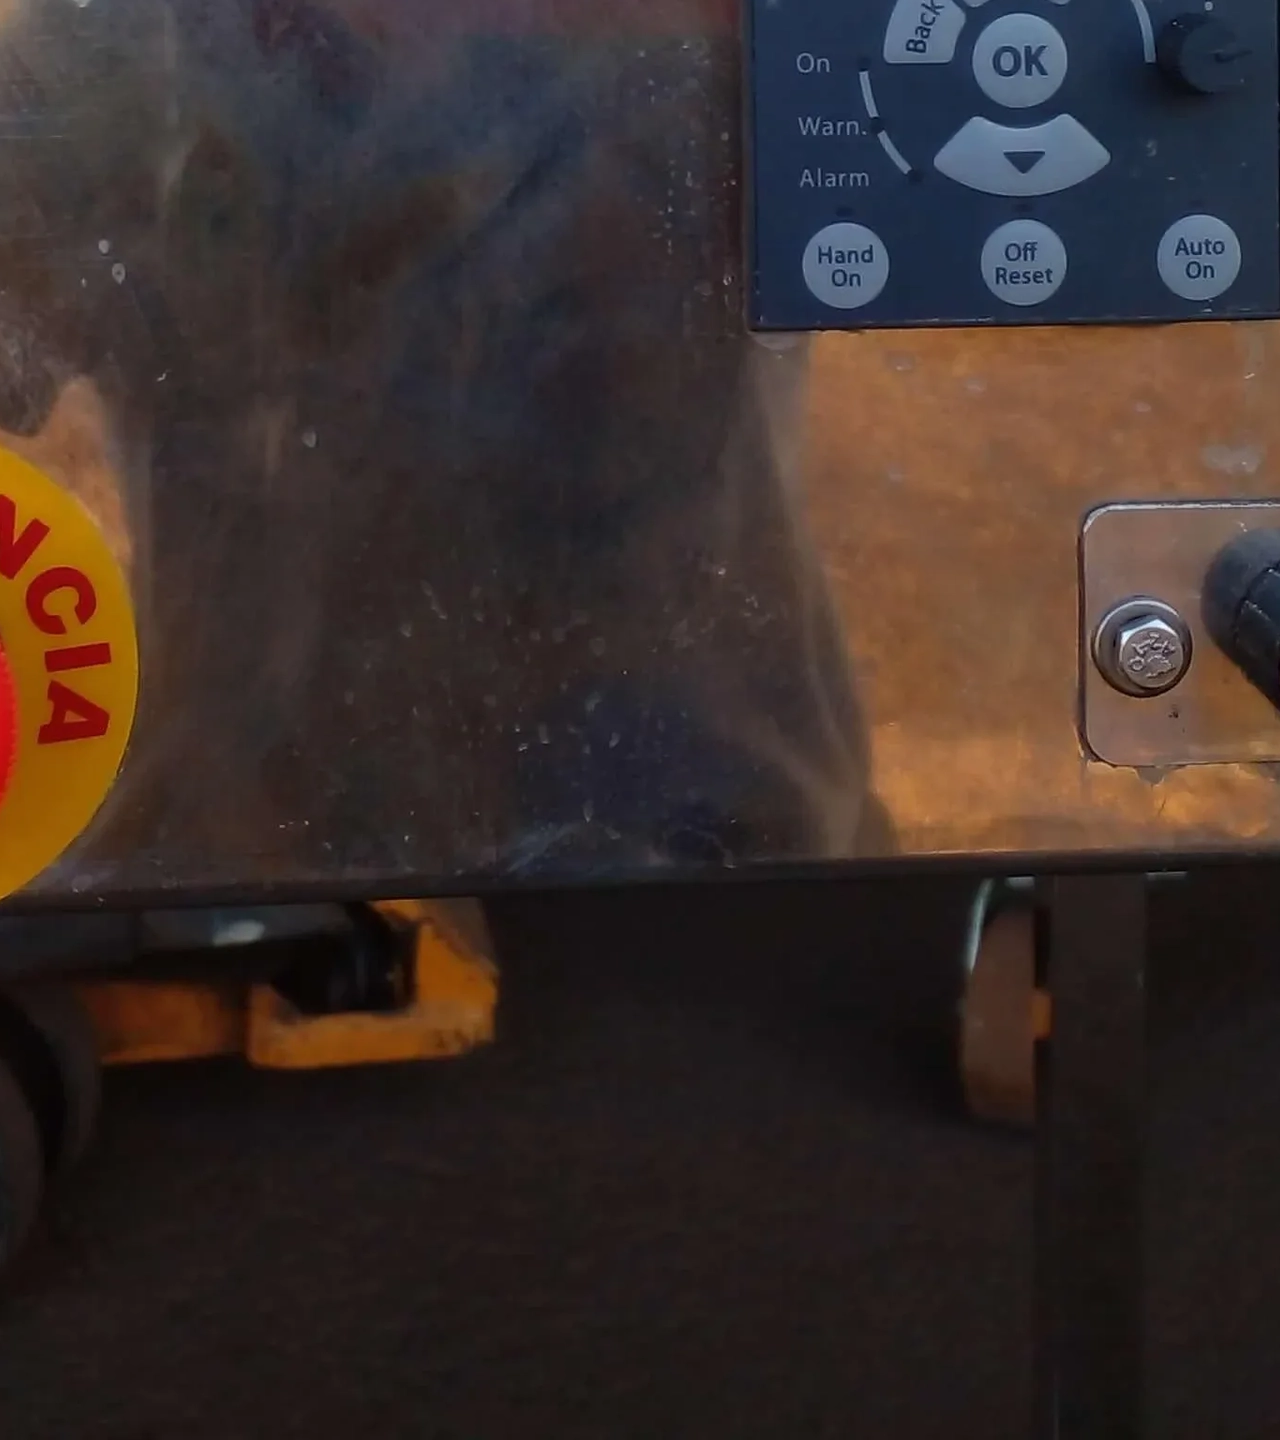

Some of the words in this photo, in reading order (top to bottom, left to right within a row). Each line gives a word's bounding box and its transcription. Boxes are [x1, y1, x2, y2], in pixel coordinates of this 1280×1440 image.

[906, 0, 944, 53] Back
[797, 53, 829, 73] On
[993, 46, 1048, 77] OK
[798, 117, 868, 136] Warn.
[800, 168, 869, 187] Alarm
[819, 245, 873, 264] Hand
[1005, 242, 1037, 261] Off
[1175, 238, 1225, 256] Auto
[832, 269, 860, 287] On
[996, 267, 1052, 285] Reset
[1186, 261, 1214, 279] On
